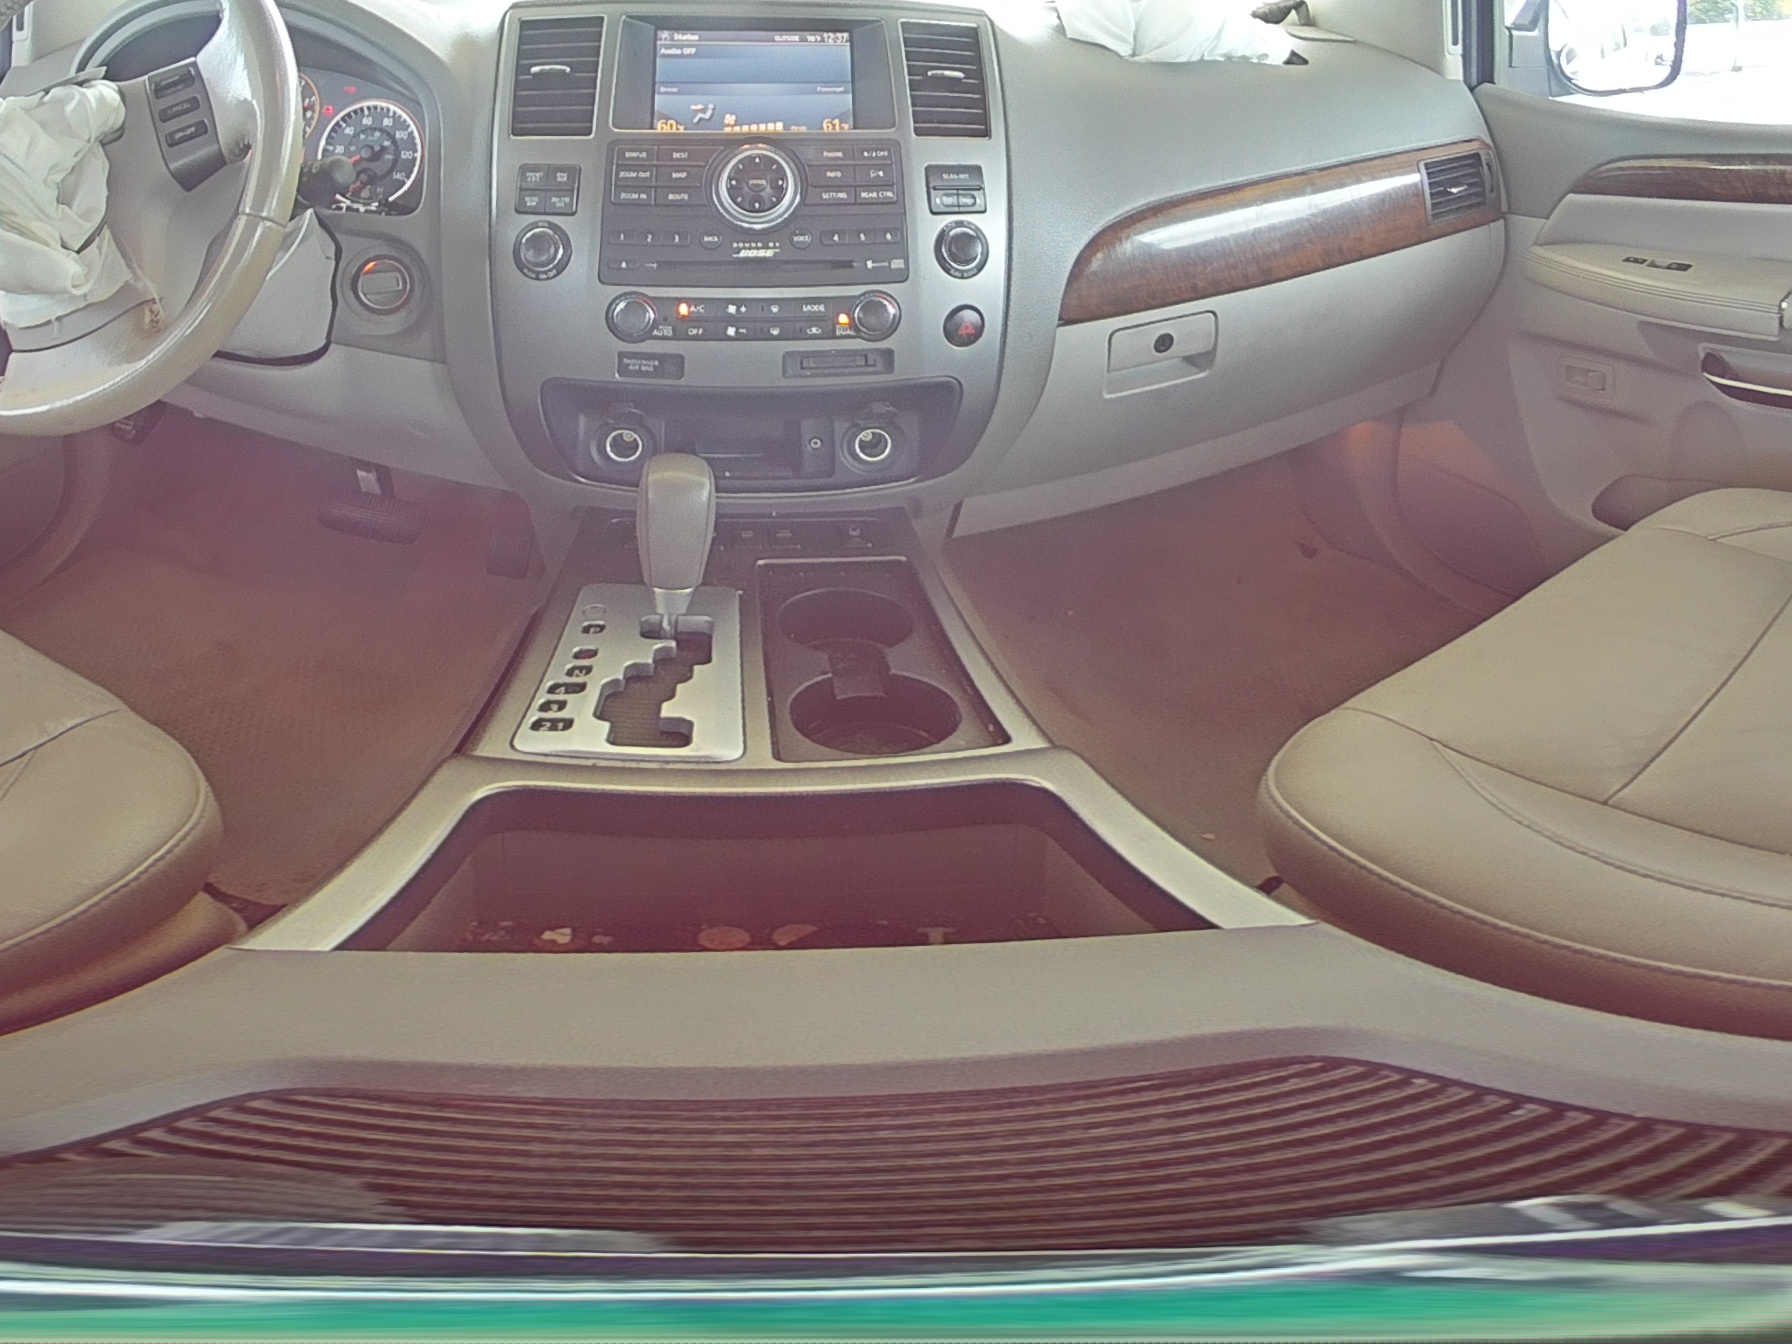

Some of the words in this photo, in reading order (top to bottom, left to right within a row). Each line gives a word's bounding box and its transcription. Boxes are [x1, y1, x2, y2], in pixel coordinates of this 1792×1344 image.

[362, 117, 372, 125] 60
[383, 118, 393, 126] 80
[344, 126, 354, 134] 40
[396, 130, 408, 139] 100
[335, 145, 344, 153] 20
[690, 305, 705, 313] A/C
[688, 327, 704, 335] OFF
